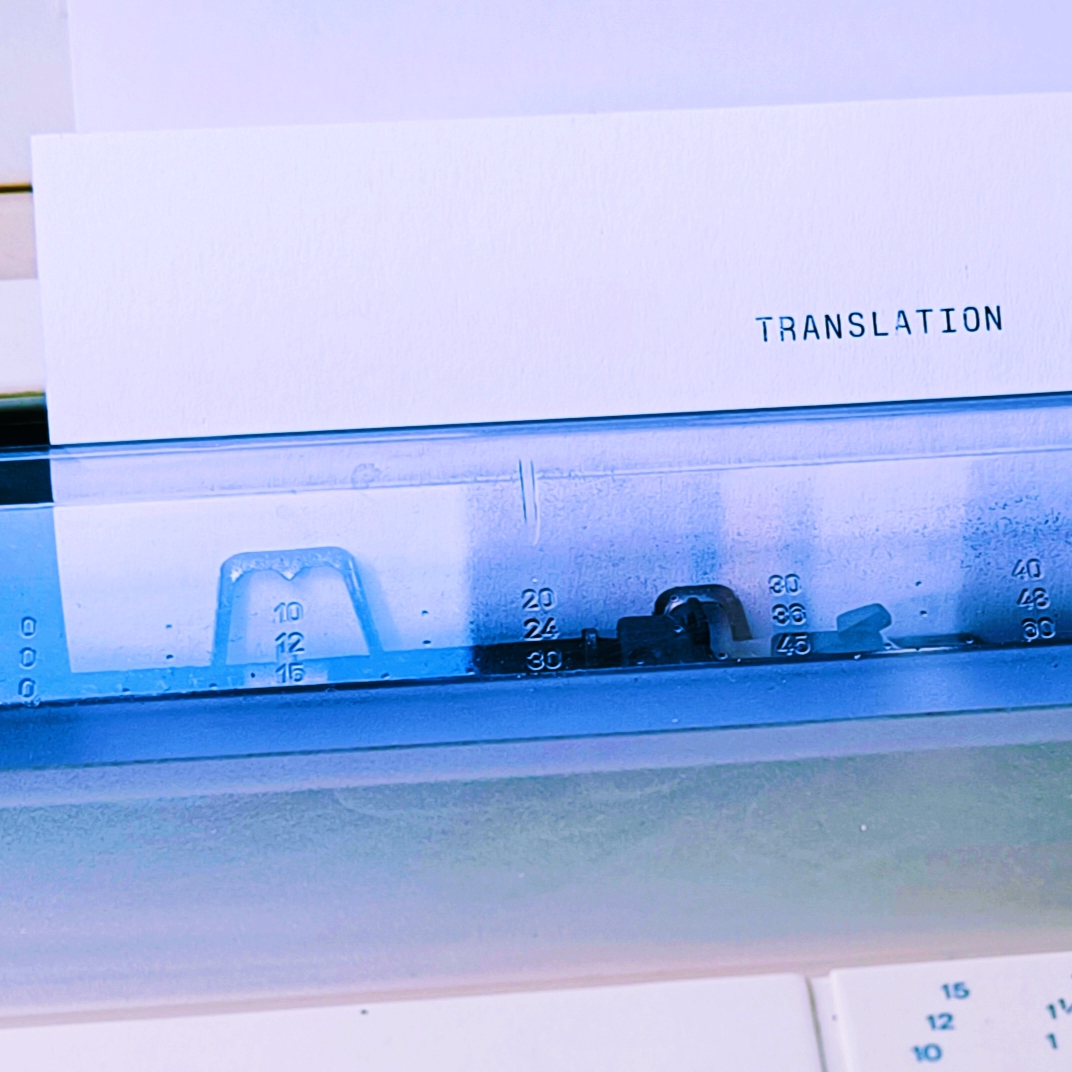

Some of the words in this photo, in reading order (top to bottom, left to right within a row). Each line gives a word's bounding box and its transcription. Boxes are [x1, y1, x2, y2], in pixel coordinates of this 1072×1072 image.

[755, 305, 1003, 343] TRANSLATION
[273, 602, 303, 623] 10
[521, 588, 557, 612] 20
[768, 574, 802, 596] 30
[1012, 558, 1044, 580] 40
[275, 631, 305, 656] 12
[523, 617, 559, 640] 24
[1017, 587, 1051, 610] 48
[526, 650, 563, 670] 30
[776, 632, 812, 655] 45
[942, 982, 970, 999] 15
[927, 1012, 954, 1031] 12
[913, 1043, 943, 1062] 10
[1047, 1033, 1058, 1049] 1
